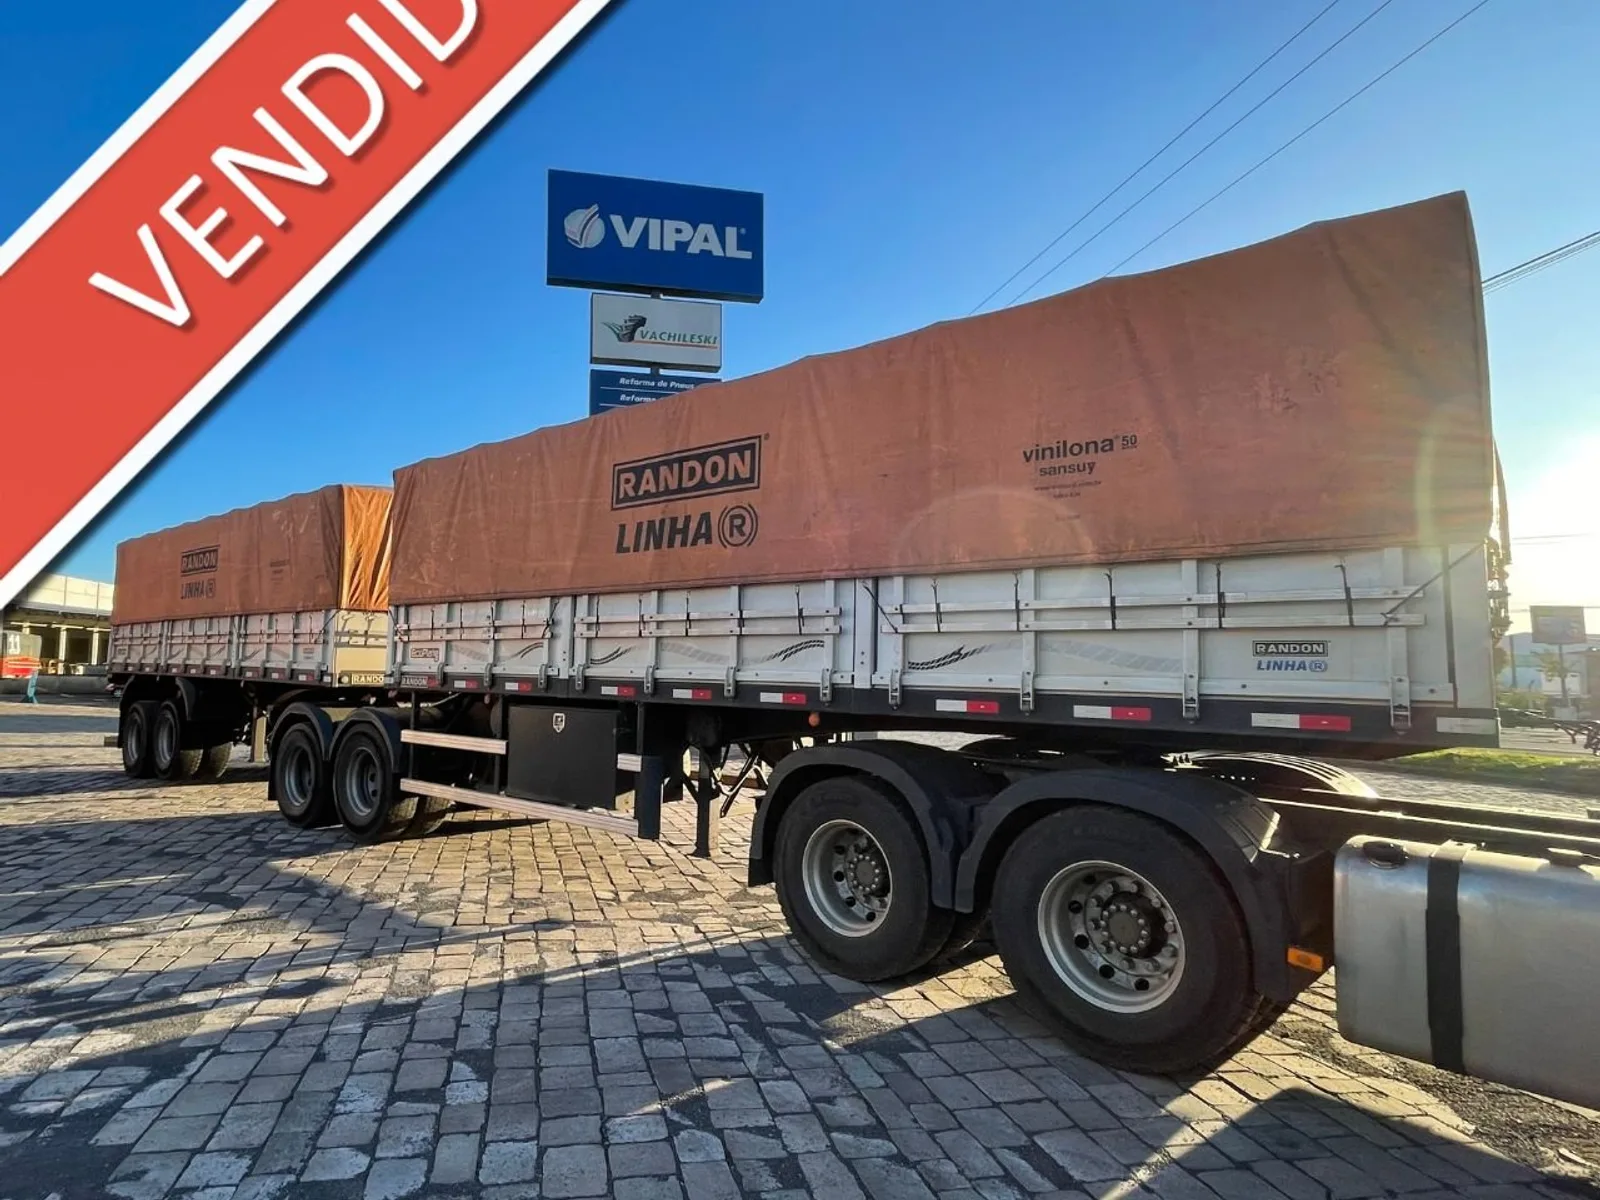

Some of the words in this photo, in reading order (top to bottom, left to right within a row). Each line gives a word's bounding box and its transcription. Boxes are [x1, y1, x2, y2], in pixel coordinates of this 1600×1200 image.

[609, 214, 753, 260] VIPAL
[640, 329, 718, 345] VACHILESKI
[619, 377, 655, 386] Reforma
[657, 379, 668, 388] de
[669, 381, 695, 390] Pneus
[1023, 438, 1114, 463] vinilona
[1121, 434, 1138, 447] 50
[618, 449, 752, 500] RANDON
[1039, 461, 1097, 476] sansuy
[615, 511, 713, 554] LINHA
[181, 551, 217, 571] RANDON
[1256, 643, 1324, 653] RANDON
[1256, 660, 1308, 671] LINHA
